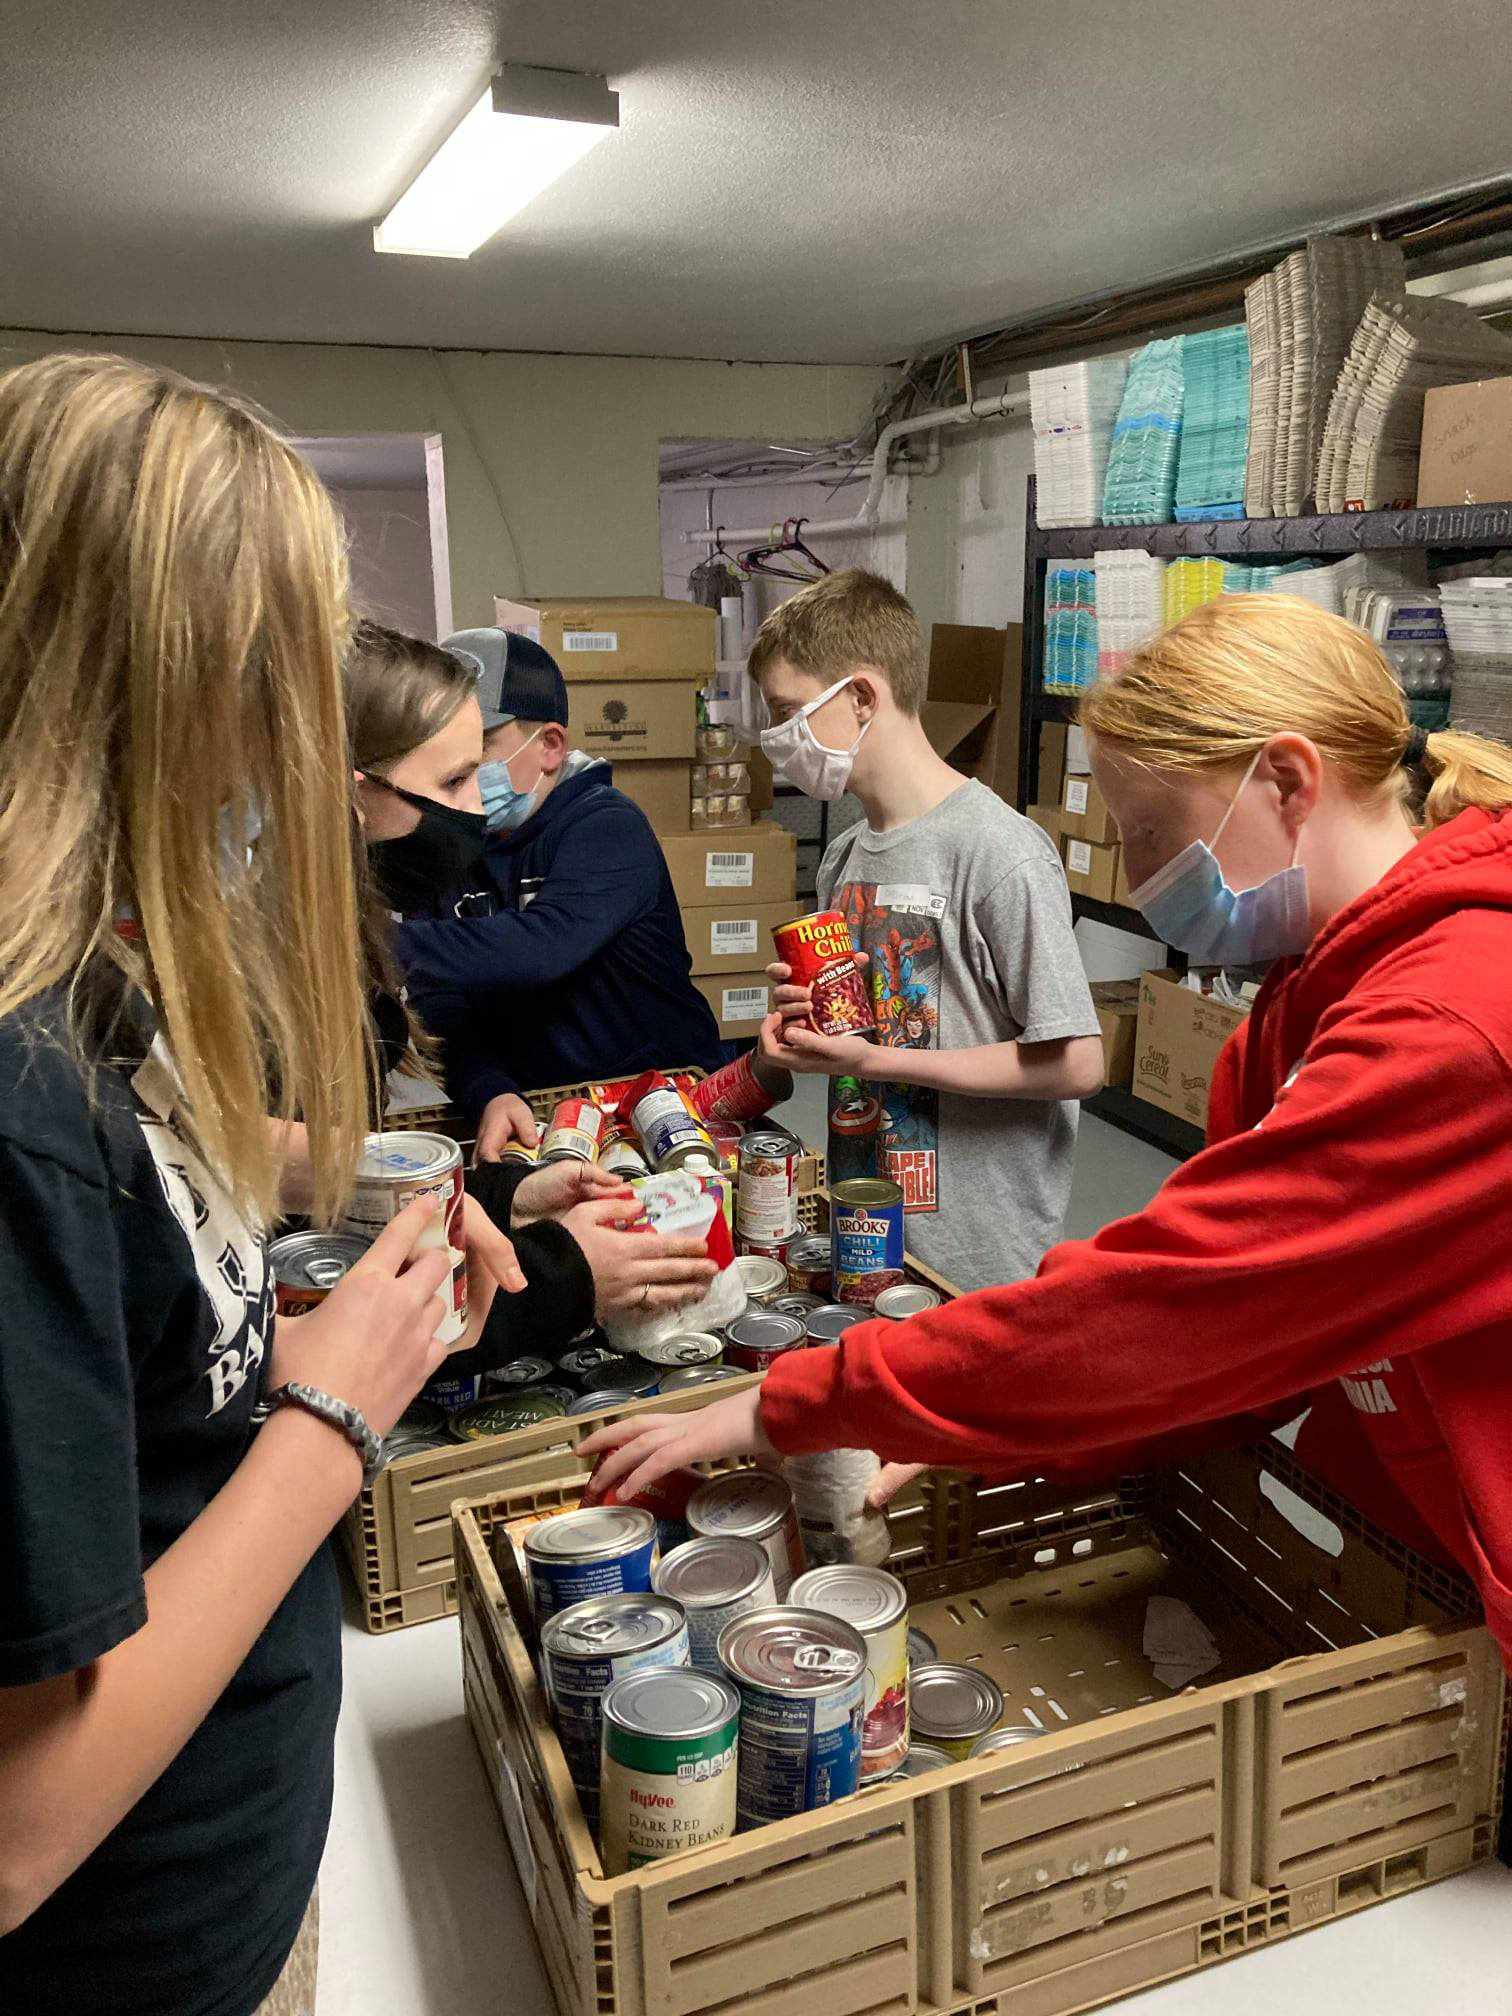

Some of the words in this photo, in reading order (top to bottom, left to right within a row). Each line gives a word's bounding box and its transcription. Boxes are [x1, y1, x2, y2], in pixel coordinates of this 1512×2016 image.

[816, 969, 837, 985] with
[839, 1219, 887, 1236] BROOKS
[842, 1236, 880, 1248] CHILI
[851, 1248, 873, 1256] MILD
[840, 1255, 885, 1266] BEANS
[782, 1711, 808, 1720] Facts
[681, 1765, 693, 1775] 110
[628, 1813, 667, 1833] DARK
[672, 1818, 701, 1833] RED
[627, 1831, 684, 1850] KIDNEY
[687, 1823, 726, 1848] BEANS
